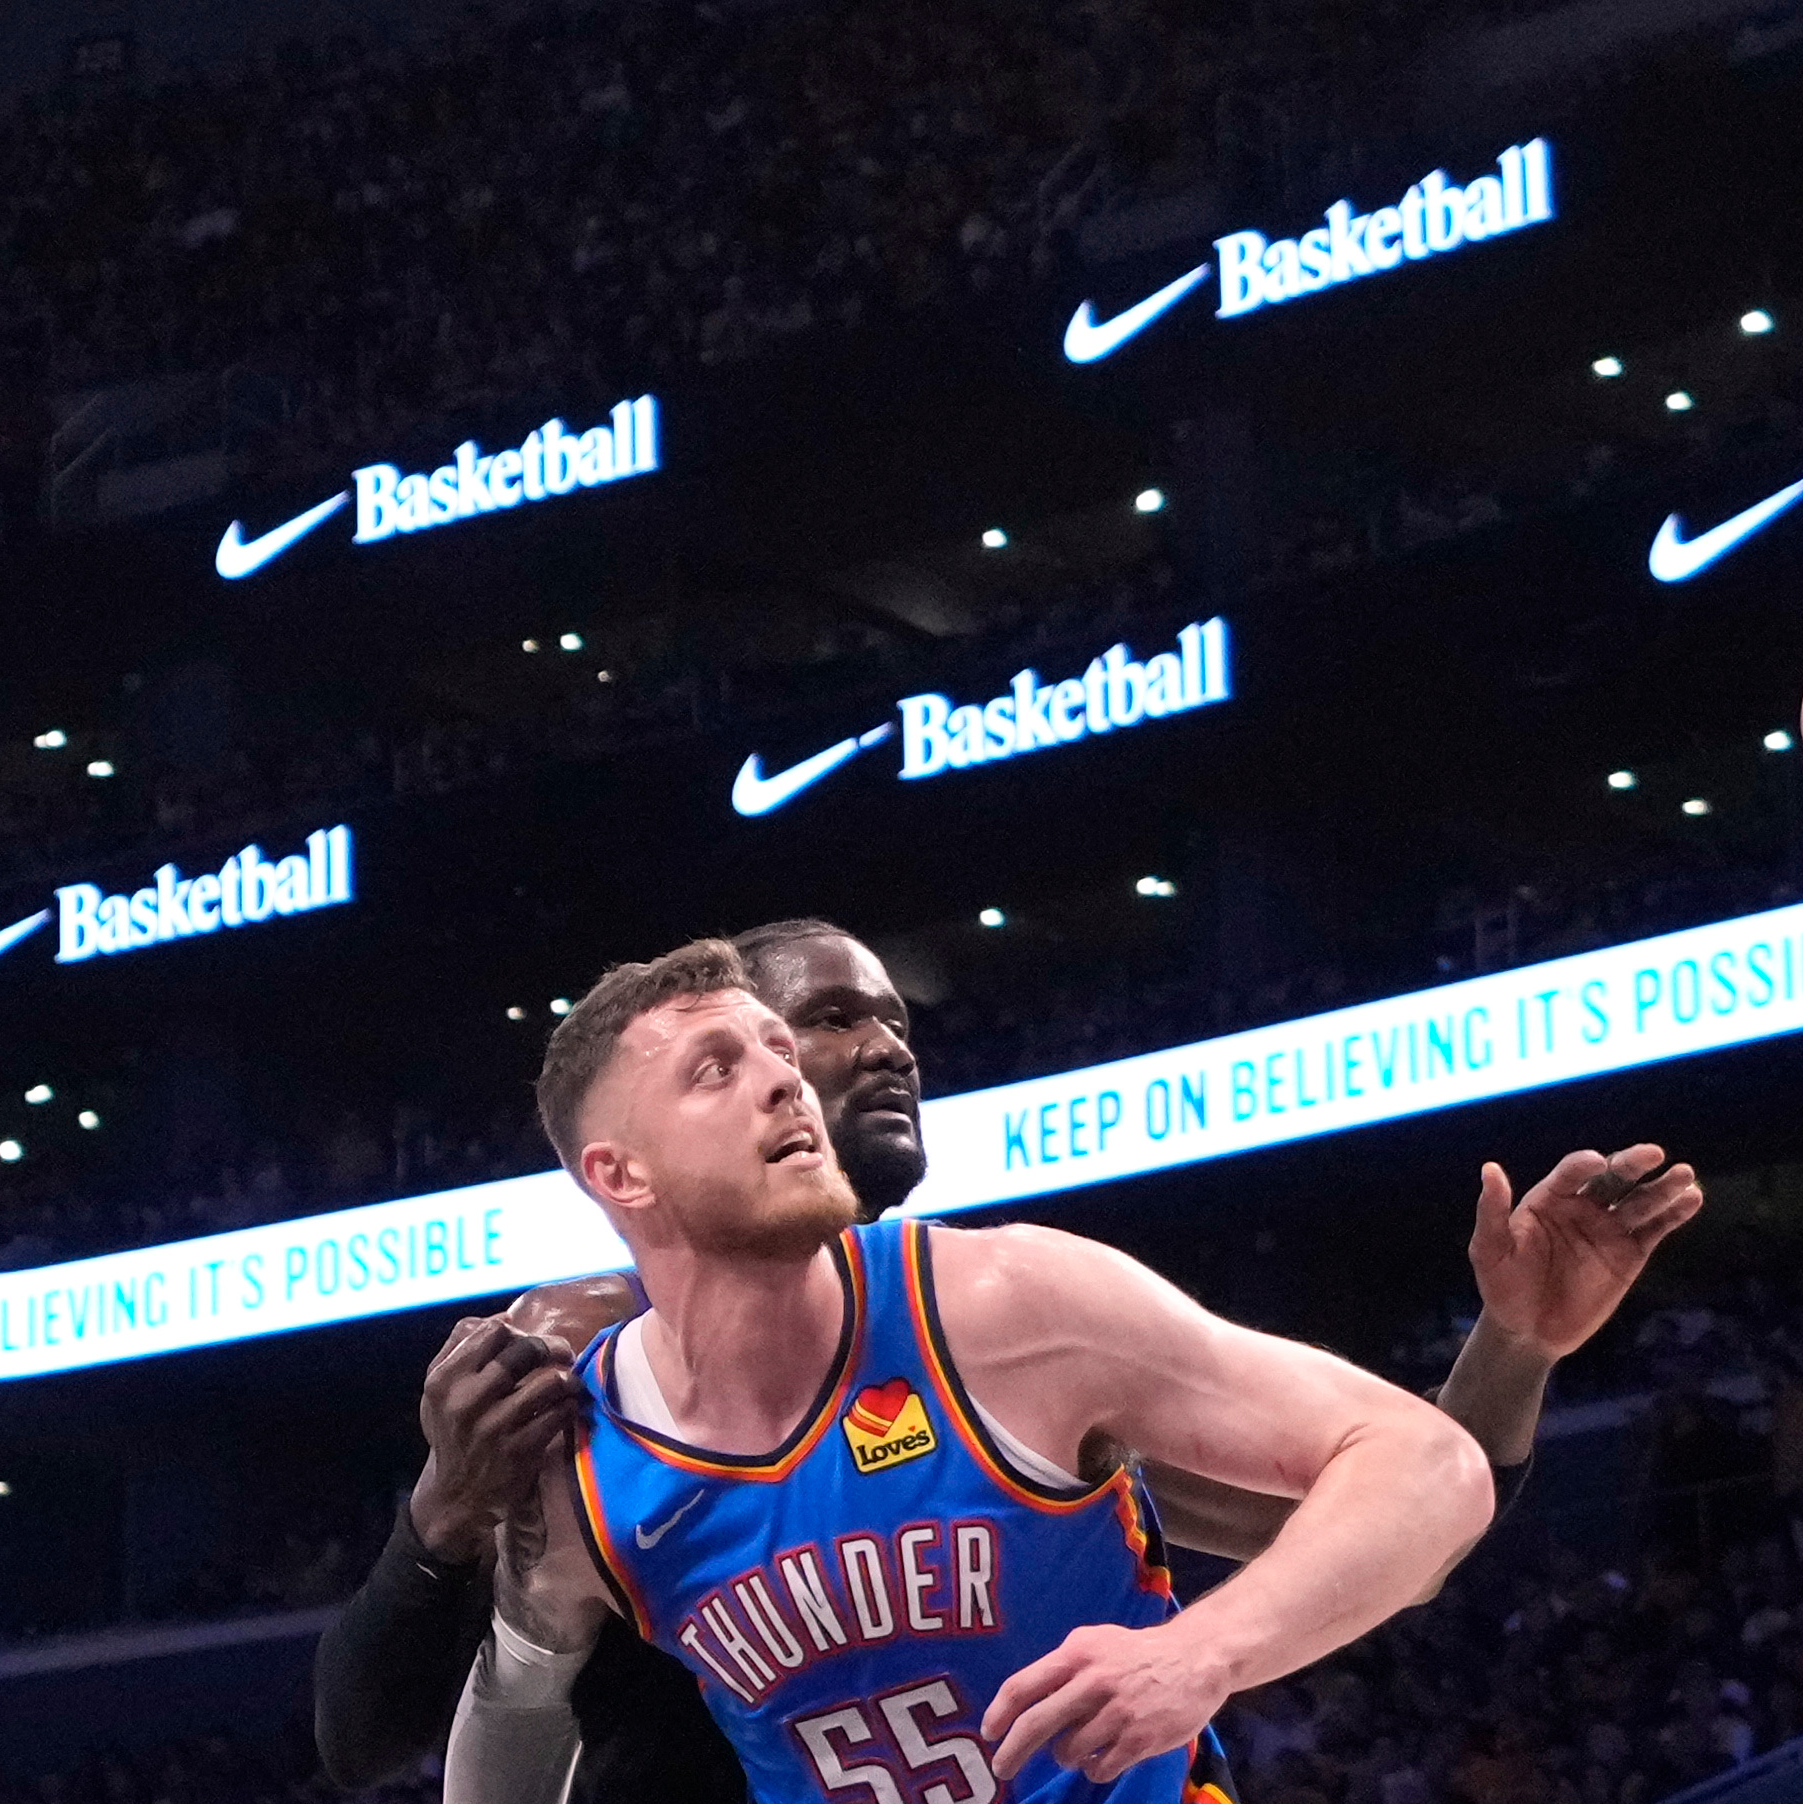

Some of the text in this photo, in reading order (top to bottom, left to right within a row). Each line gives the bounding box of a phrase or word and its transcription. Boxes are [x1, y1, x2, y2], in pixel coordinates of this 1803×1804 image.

[1213, 137, 1553, 318] Basketball
[351, 394, 660, 544] Basketball
[895, 616, 1230, 780] Basketball
[53, 824, 354, 965] Basketball
[1003, 1089, 1121, 1171] KEEP
[1145, 1070, 1207, 1140] ON
[1230, 1006, 1493, 1122] BELIEVING
[1518, 981, 1611, 1059] IT'S
[189, 1253, 265, 1319] IT'S
[284, 1208, 504, 1300] POSSIBLE
[680, 1526, 995, 1703] THUNDER
